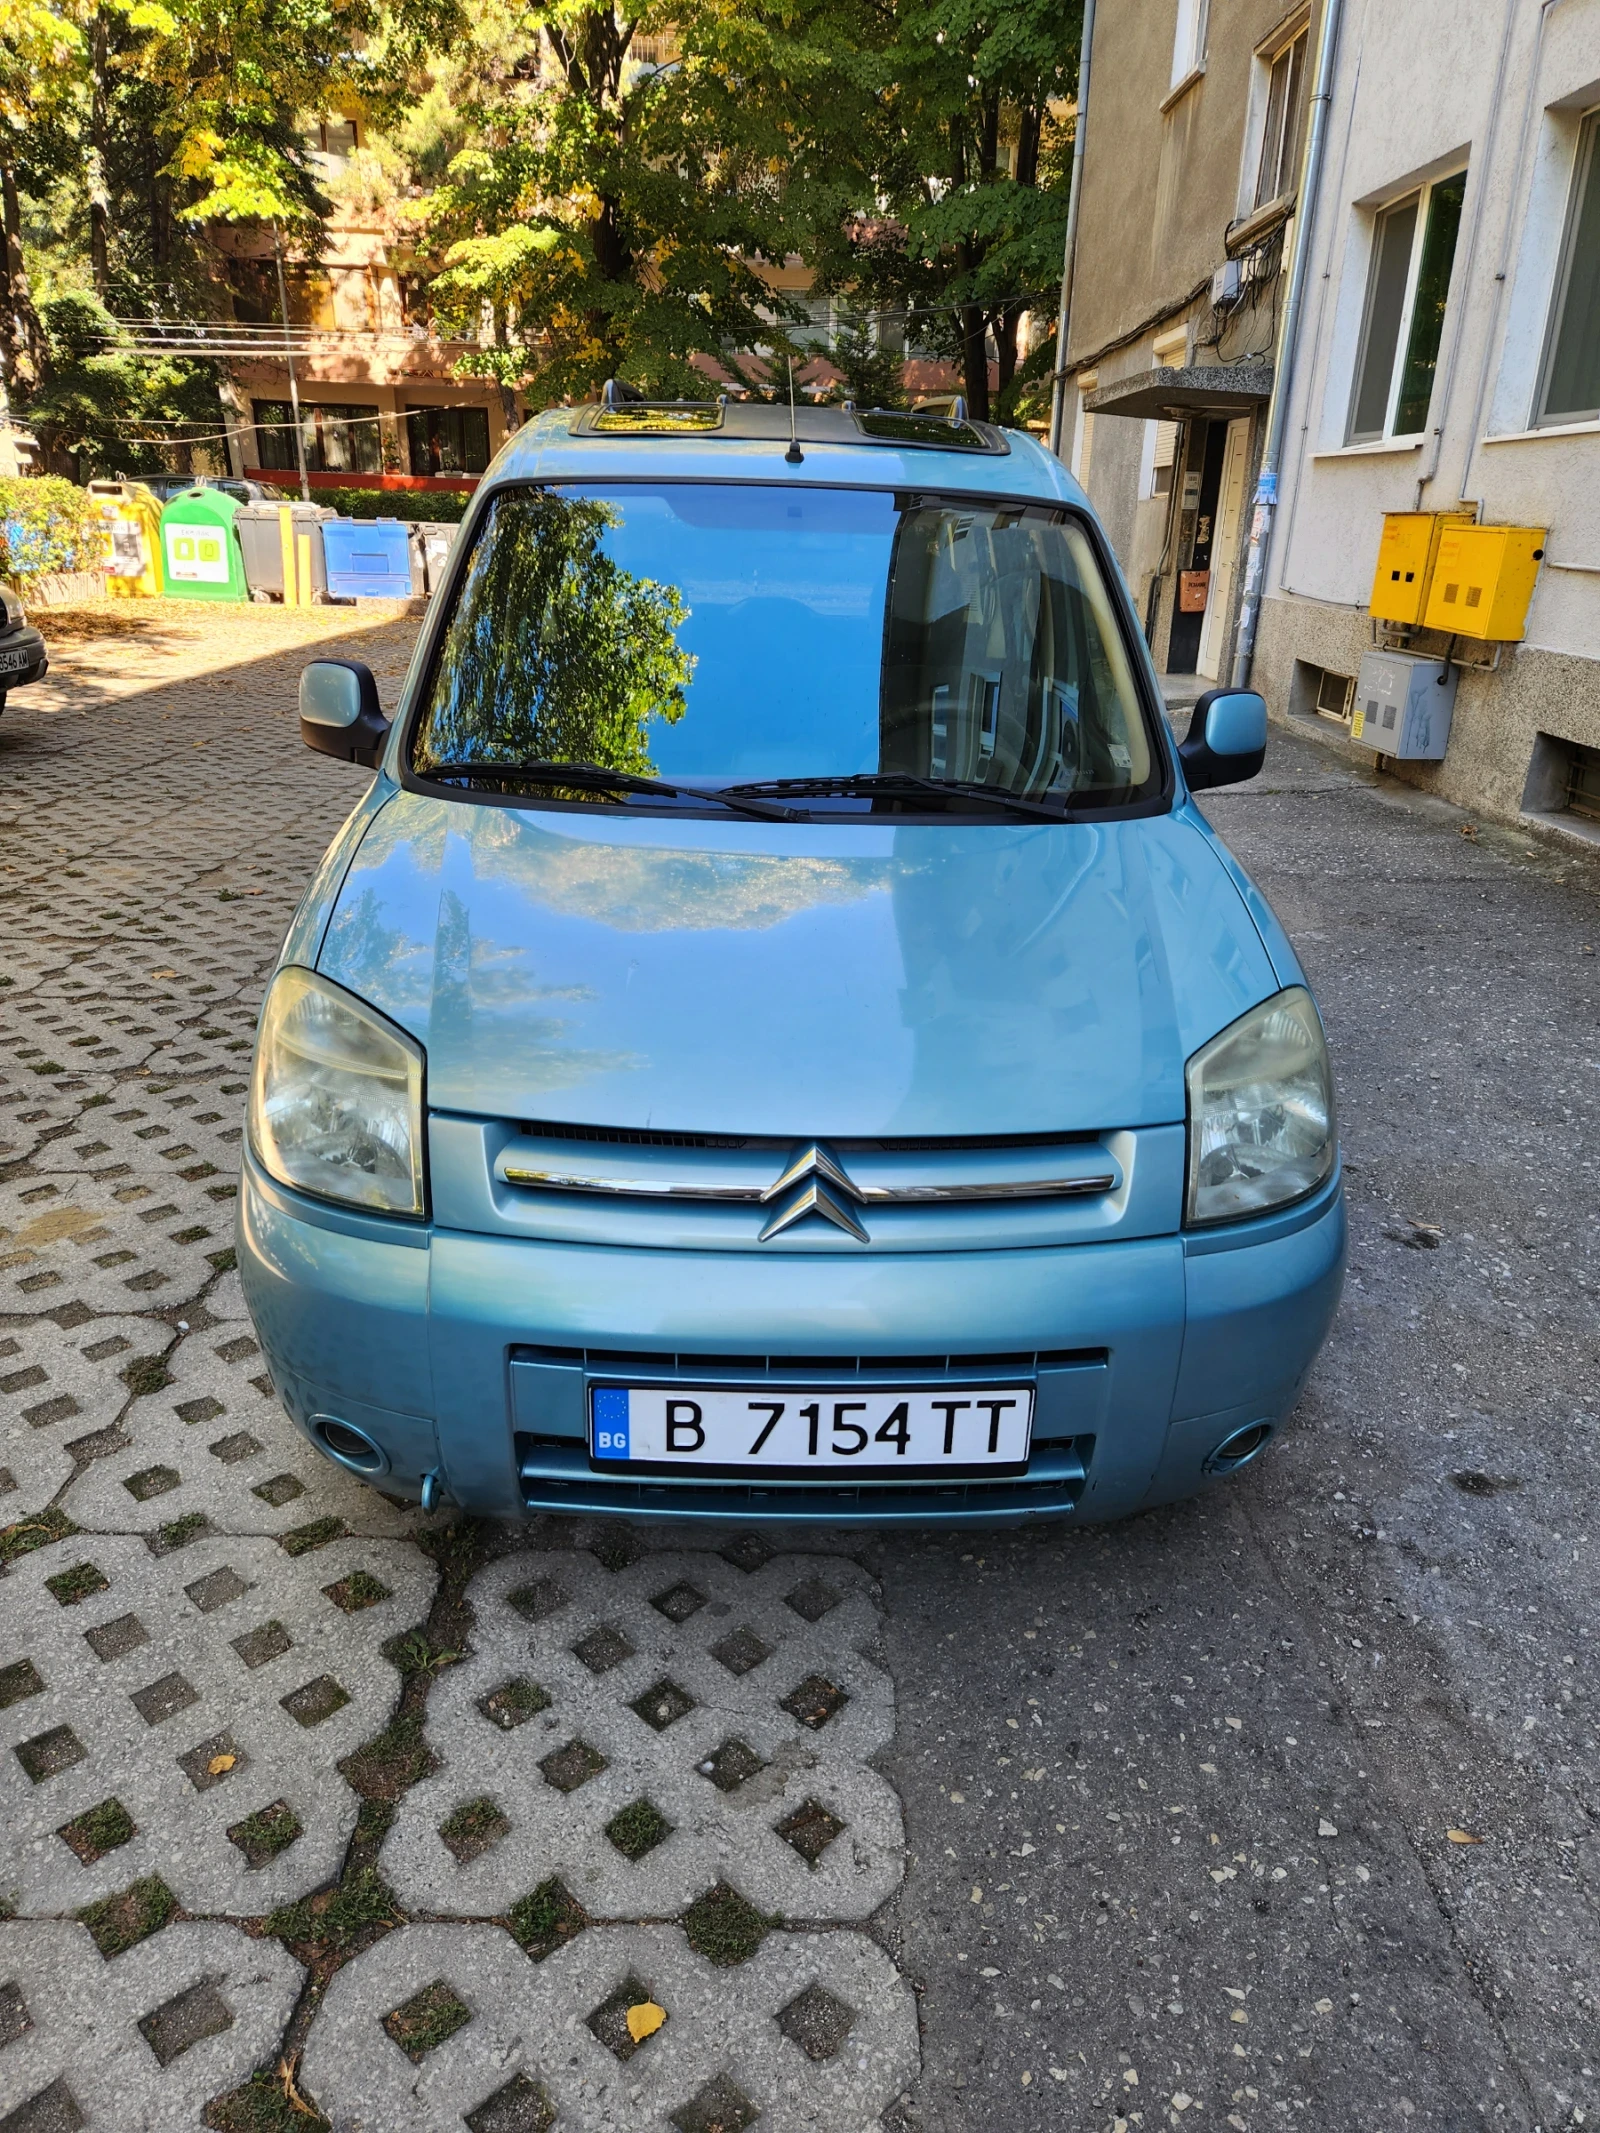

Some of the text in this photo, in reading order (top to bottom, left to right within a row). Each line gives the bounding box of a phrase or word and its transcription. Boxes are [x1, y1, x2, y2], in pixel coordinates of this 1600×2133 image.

[598, 1432, 626, 1449] BG
[665, 1399, 1017, 1456] B 7154 TT
